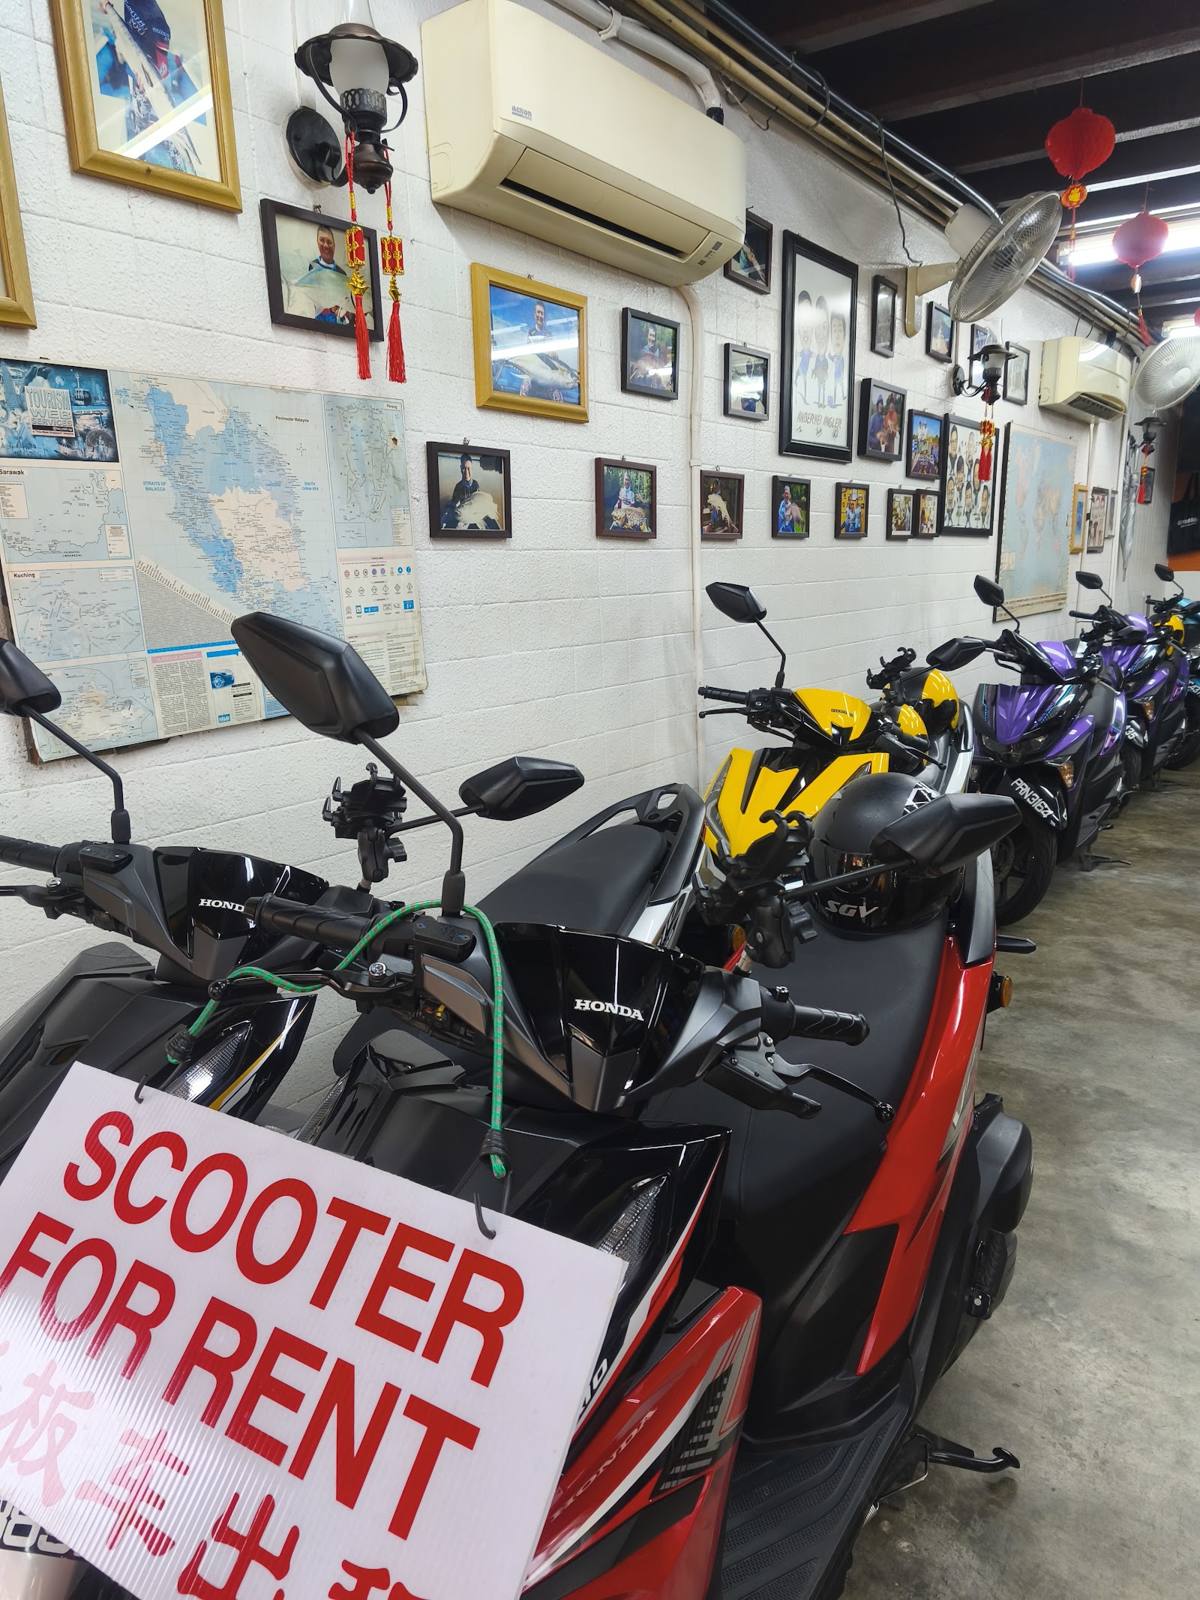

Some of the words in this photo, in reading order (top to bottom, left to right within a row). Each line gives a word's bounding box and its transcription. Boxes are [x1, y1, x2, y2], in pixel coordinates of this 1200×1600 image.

[1010, 777, 1054, 818] PRN3164
[199, 898, 246, 913] HOND
[825, 898, 879, 918] SGV
[574, 998, 645, 1021] HONDA
[63, 1110, 525, 1388] SCOOTER
[0, 1212, 177, 1381] FOR
[162, 1296, 481, 1541] RENT
[0, 1342, 437, 1600] 板车出
